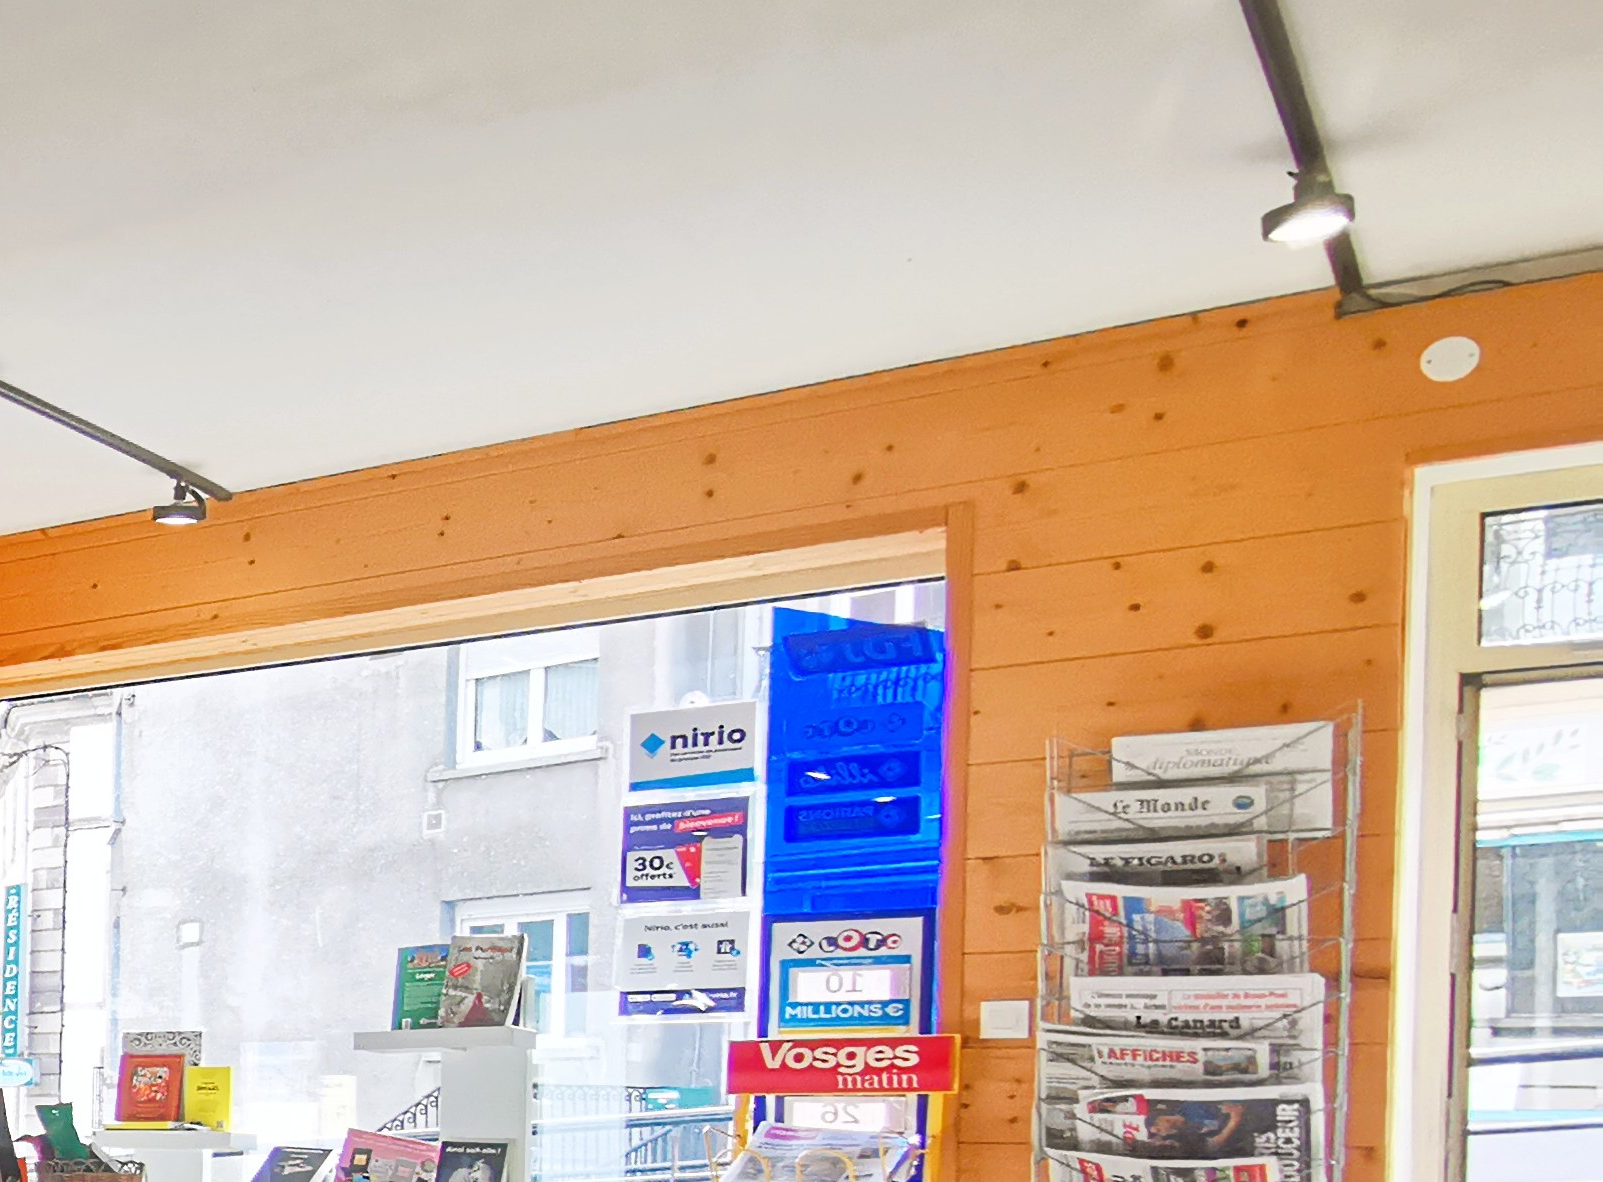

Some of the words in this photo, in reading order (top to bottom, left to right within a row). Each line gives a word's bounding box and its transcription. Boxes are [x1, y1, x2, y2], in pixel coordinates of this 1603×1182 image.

[670, 724, 746, 750] nirio
[1111, 800, 1130, 815] Le
[1136, 796, 1211, 814] Monde
[1120, 852, 1216, 868] FIGARO
[819, 928, 902, 953] LOTO
[785, 1004, 884, 1019] MILLIONS
[885, 1003, 904, 1017] €
[1134, 1015, 1160, 1030] Le
[1167, 1016, 1241, 1030] Canard
[759, 1041, 920, 1074] Vosges
[1107, 1048, 1199, 1065] AFFICHES
[837, 1069, 919, 1089] matin
